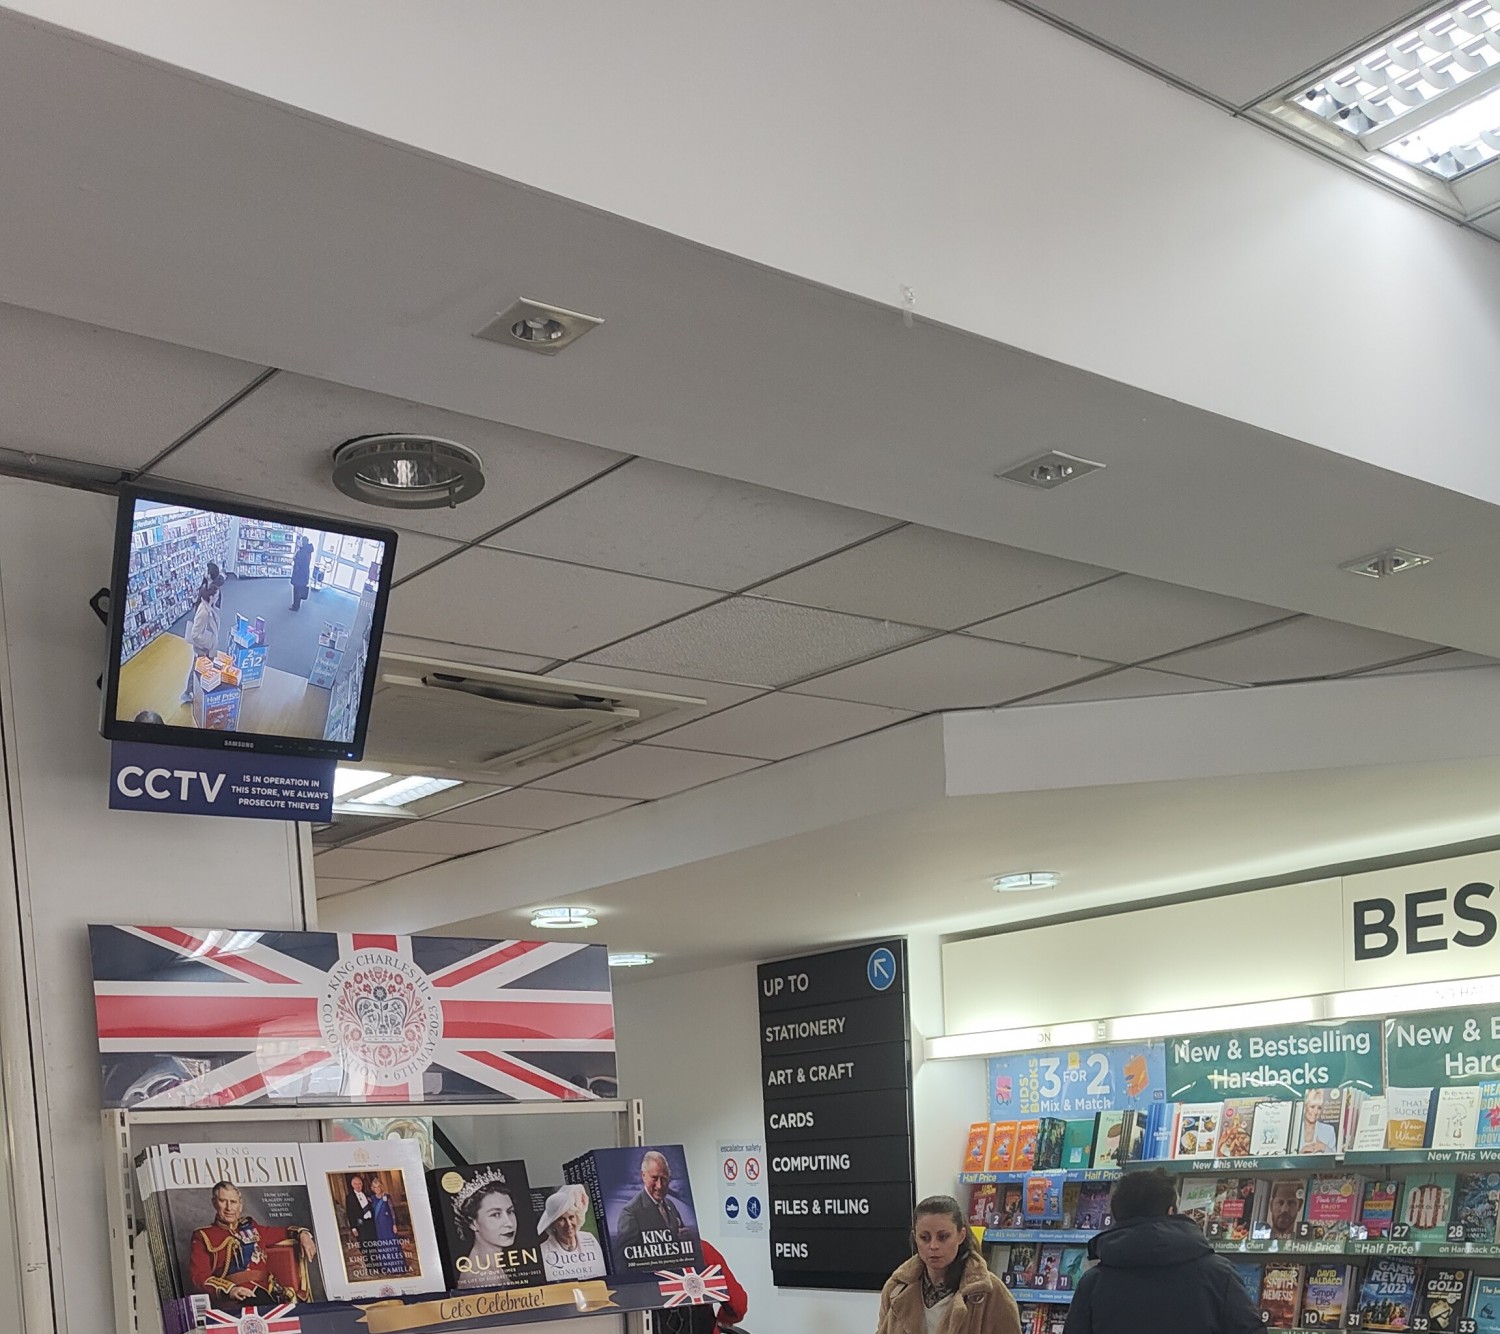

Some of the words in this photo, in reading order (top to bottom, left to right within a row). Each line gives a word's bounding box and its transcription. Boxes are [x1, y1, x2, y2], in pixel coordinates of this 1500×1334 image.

[241, 656, 262, 668] £12
[224, 740, 254, 748] SAMSUNG
[116, 766, 226, 802] CCTV
[243, 774, 251, 782] IS
[252, 776, 262, 784] IN
[263, 776, 310, 787] OPERATION
[311, 780, 320, 788] IN
[231, 786, 250, 794] THIS
[252, 787, 280, 797] STORE,
[282, 789, 296, 797] WE
[296, 790, 329, 800] ALWAYS
[238, 798, 286, 808] PROSECUTE
[288, 801, 320, 810] THIEVES
[1353, 880, 1500, 962] BES
[328, 960, 355, 991] KING
[356, 954, 416, 978] CHARLES
[414, 976, 430, 993] III
[764, 976, 784, 997] UP
[788, 973, 809, 993] TO
[765, 1016, 846, 1042] STATIONERY
[394, 1062, 418, 1080] 6TH
[417, 1042, 436, 1068] MAY
[429, 1006, 439, 1036] 2023
[1174, 1039, 1220, 1064] New
[1227, 1039, 1242, 1060] &
[1250, 1028, 1371, 1058] Bestselling
[768, 1068, 793, 1086] ART
[796, 1066, 806, 1084] &
[809, 1062, 854, 1082] CRAFT
[1039, 1058, 1062, 1098] 3
[1063, 1070, 1087, 1082] FOR
[1087, 1054, 1110, 1095] 2
[1212, 1064, 1330, 1090] Hardbacks
[1029, 1058, 1040, 1113] BOOKS
[1040, 1100, 1060, 1112] Mix
[1062, 1100, 1072, 1112] &
[1074, 1096, 1112, 1110] Match
[770, 1111, 814, 1130] CARDS
[214, 1146, 250, 1156] KING
[720, 1144, 744, 1153] escalator
[745, 1142, 762, 1154] safety
[772, 1153, 850, 1173] COMPUTING
[1428, 1152, 1451, 1161] New
[1454, 1151, 1476, 1160] This
[170, 1156, 270, 1186] CHARLES
[275, 1156, 299, 1183] III
[1192, 1161, 1211, 1170] New
[1234, 1160, 1258, 1168] Week
[962, 1173, 978, 1182] Half
[978, 1173, 996, 1182] Price
[774, 1199, 808, 1216] FILES
[812, 1199, 822, 1215] &
[824, 1198, 870, 1215] FILING
[1104, 1216, 1111, 1226] 6
[641, 1229, 672, 1244] KING
[1393, 1226, 1409, 1237] 27
[1448, 1226, 1464, 1237] 28
[362, 1238, 410, 1248] CORONATION
[624, 1242, 680, 1259] CHARLES
[680, 1241, 694, 1254] III
[775, 1242, 808, 1258] PENS
[1361, 1243, 1385, 1254] Half
[1387, 1244, 1414, 1254] Price
[370, 1252, 404, 1260] CHARLES
[456, 1248, 538, 1274] QUEEN
[545, 1250, 596, 1269] Queen
[353, 1268, 379, 1277] QUEEN
[381, 1266, 414, 1274] CAMILLA
[552, 1266, 593, 1277] CONSORT
[1317, 1269, 1337, 1277] DAVID
[1378, 1261, 1415, 1275] GAMES
[1034, 1276, 1044, 1285] 10
[1309, 1277, 1343, 1285] BALDACCI
[1371, 1270, 1416, 1284] REVIEW
[1439, 1272, 1454, 1280] The
[1379, 1282, 1407, 1294] 2023
[1427, 1280, 1463, 1292] GOLD
[440, 1300, 472, 1320] Let's
[476, 1288, 545, 1315] Celebrate!
[1305, 1312, 1318, 1324] 10
[1413, 1319, 1428, 1330] 32
